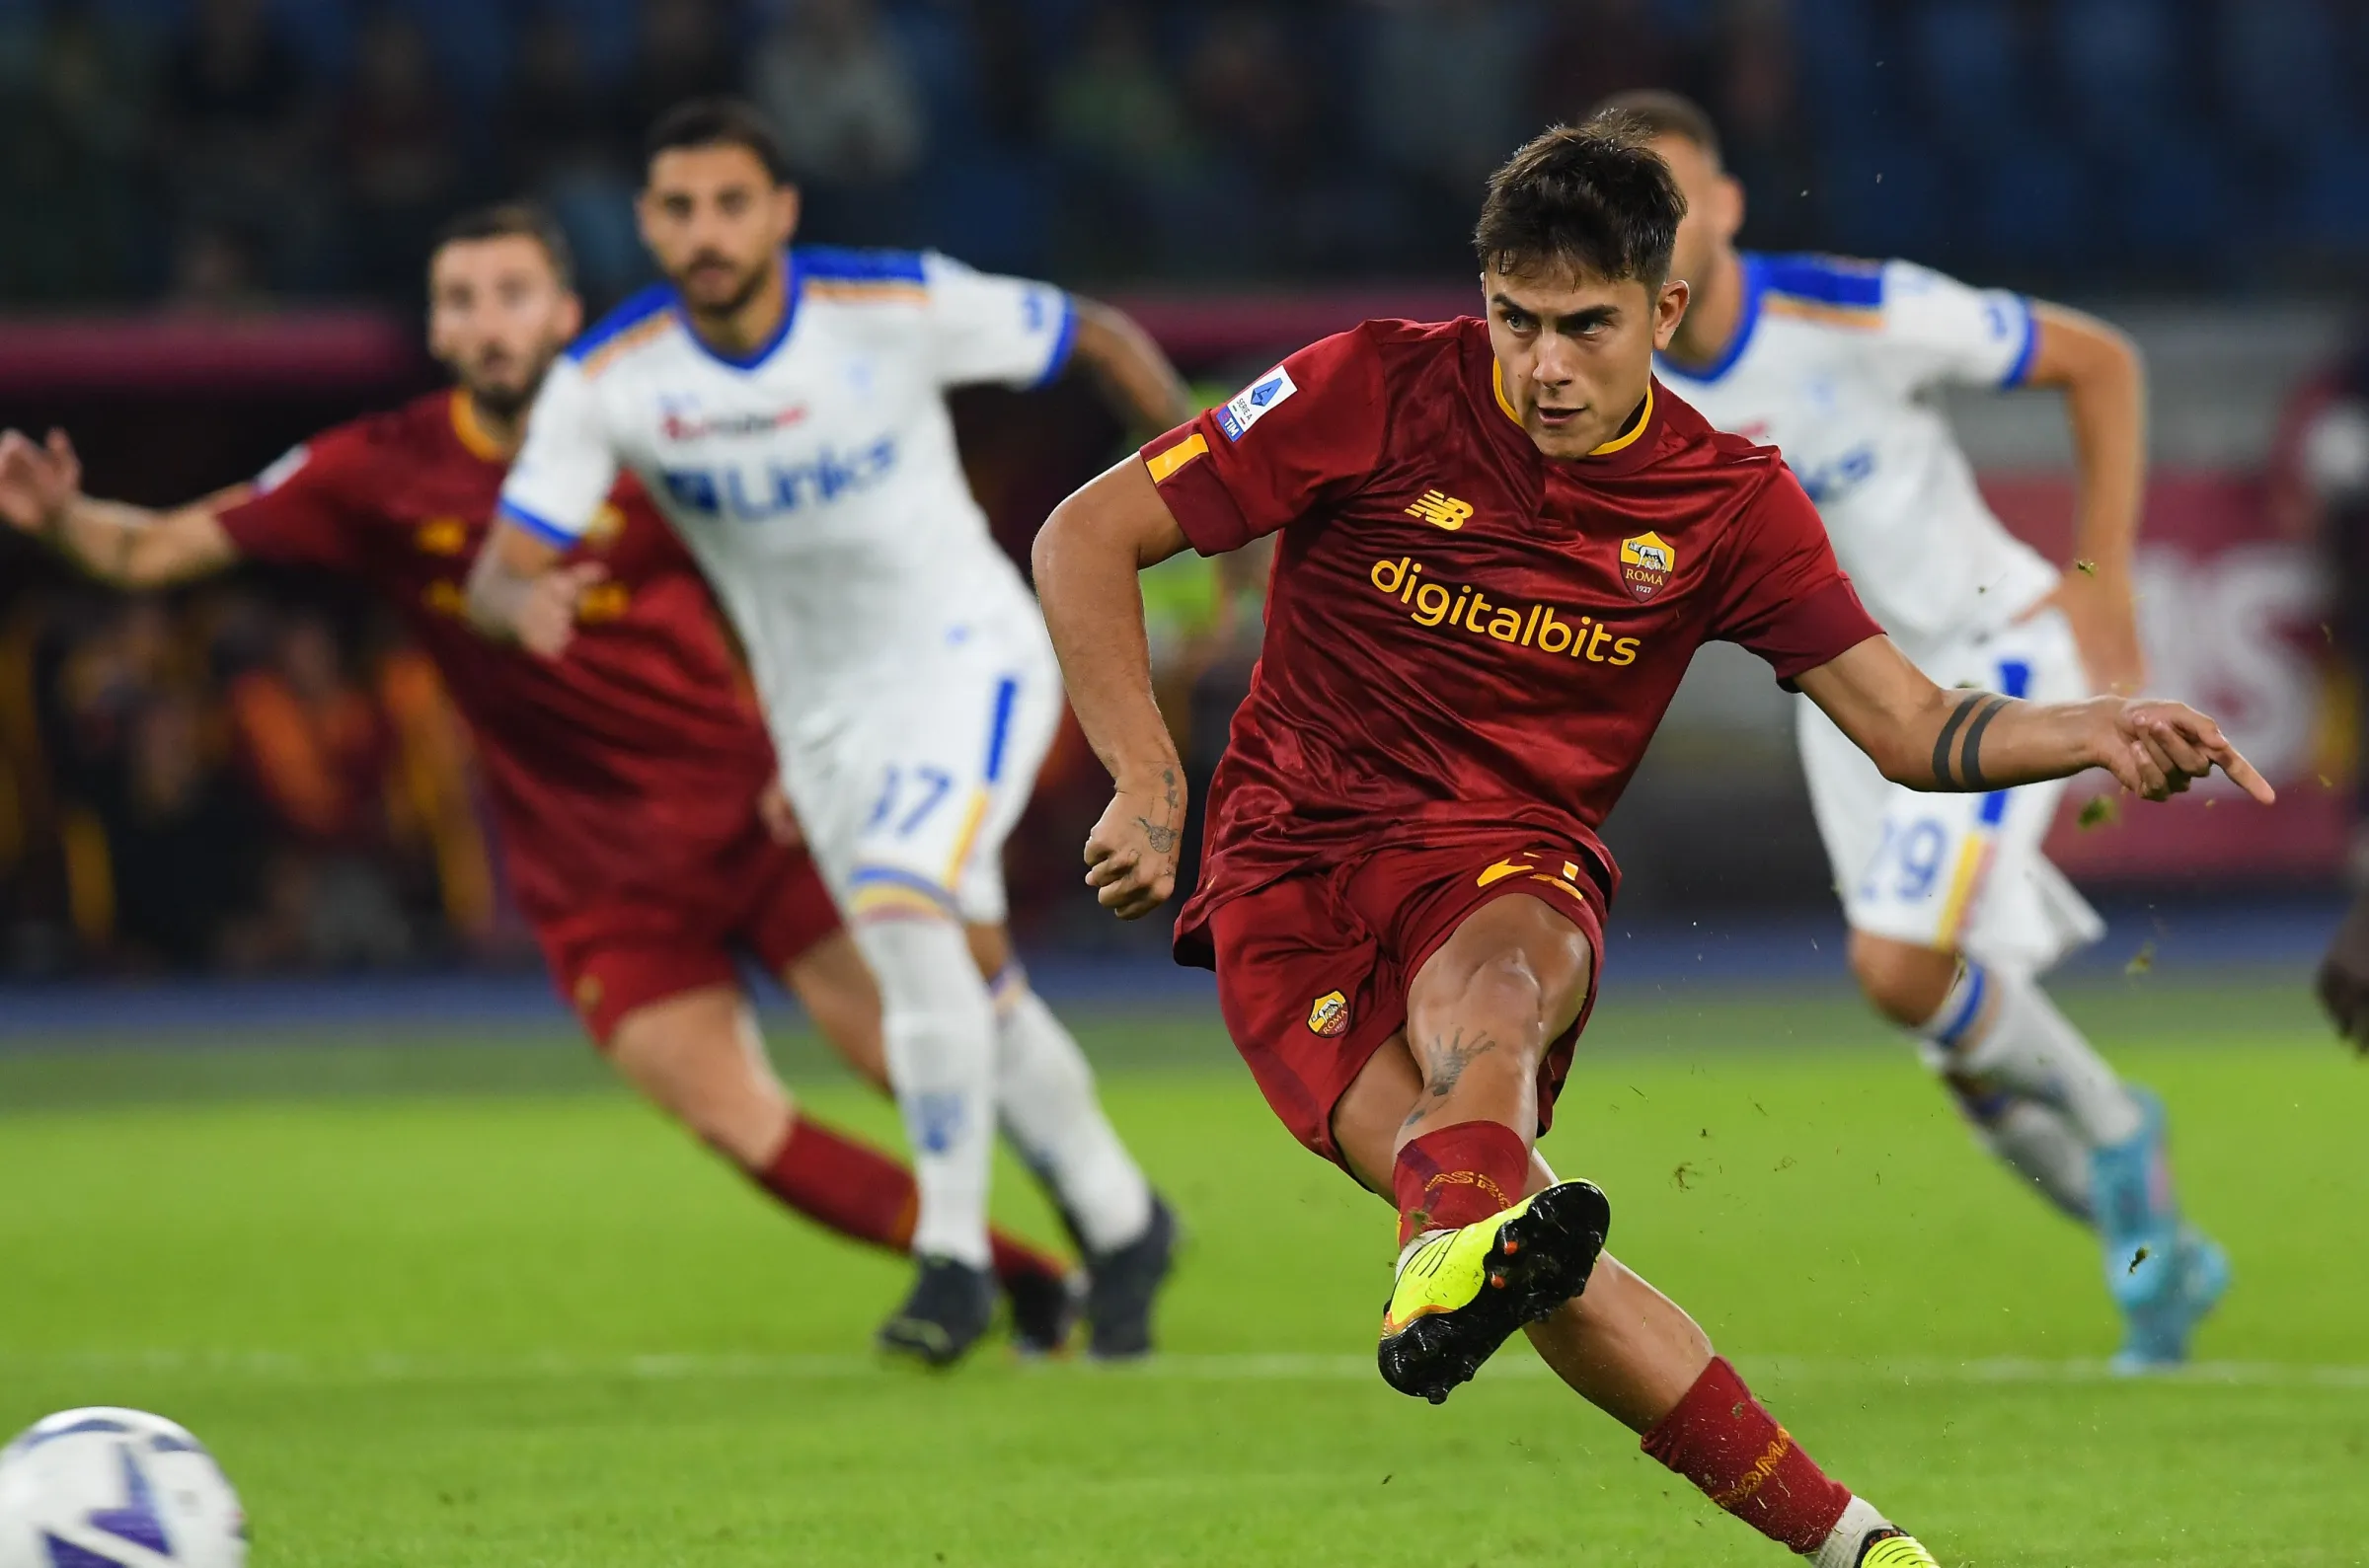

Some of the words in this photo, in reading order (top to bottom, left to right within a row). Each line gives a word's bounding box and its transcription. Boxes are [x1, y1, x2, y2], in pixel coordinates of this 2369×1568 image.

[1237, 398, 1251, 415] SERIE
[1224, 417, 1240, 437] TIM
[1625, 568, 1663, 586] ROMA
[1636, 584, 1652, 594] 1927
[1371, 557, 1642, 666] digitalbits
[1323, 1009, 1348, 1034] ROMA
